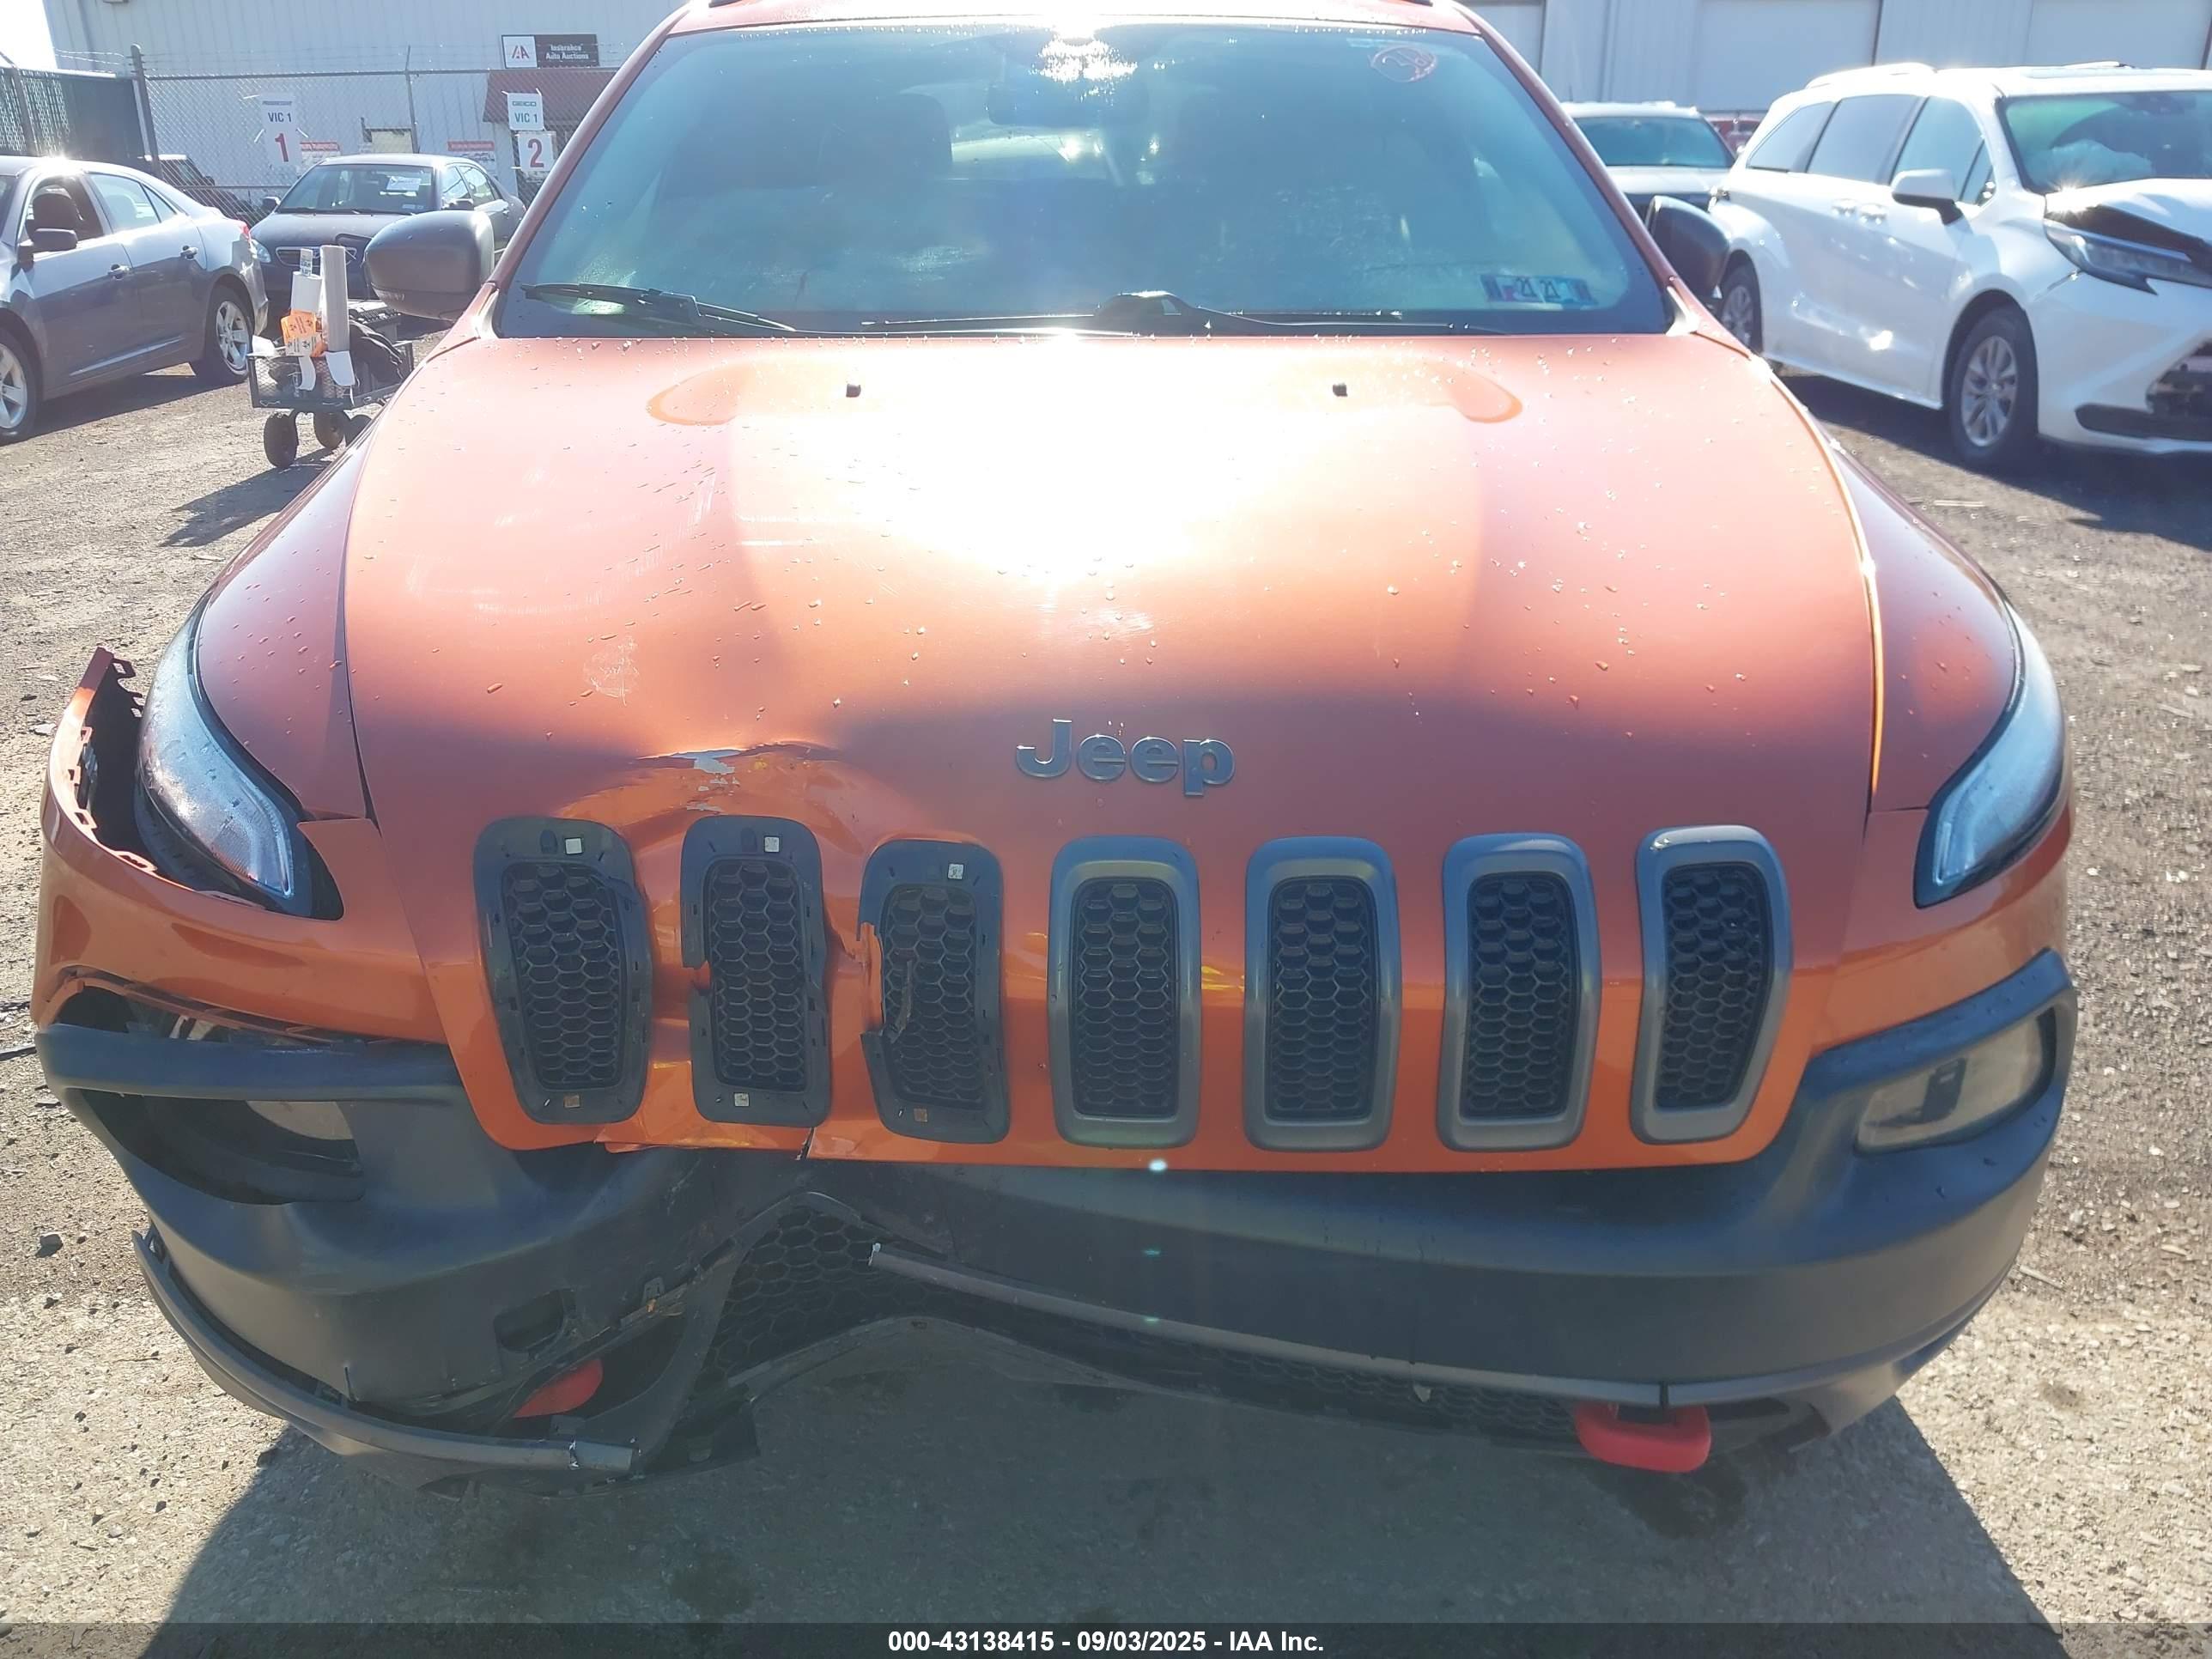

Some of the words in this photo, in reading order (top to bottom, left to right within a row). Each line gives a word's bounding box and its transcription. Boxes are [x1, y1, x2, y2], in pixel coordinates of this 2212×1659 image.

[268, 112, 284, 122] VIC
[287, 112, 292, 122] 1
[514, 112, 531, 123] VIC
[533, 113, 538, 124] 1
[275, 132, 289, 162] 1
[527, 137, 545, 168] 2
[1017, 719, 1236, 797] Jeep
